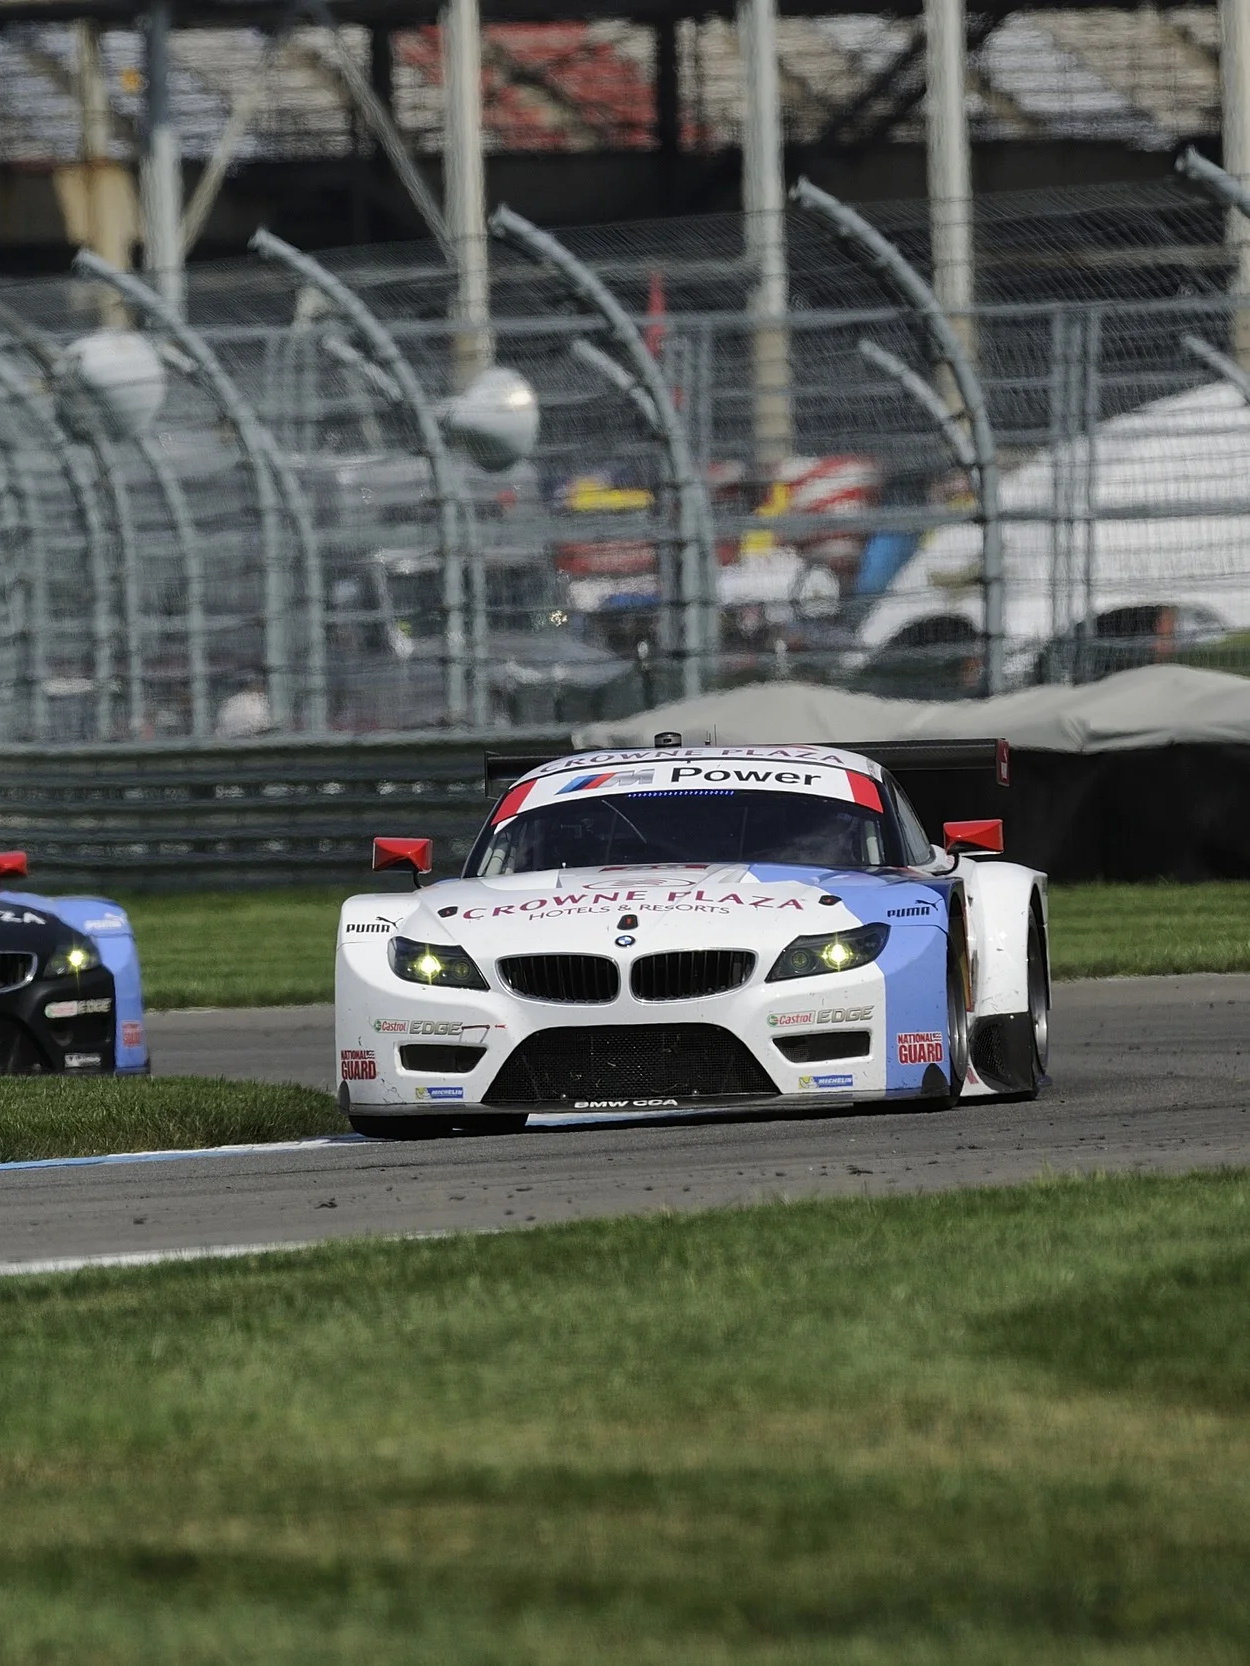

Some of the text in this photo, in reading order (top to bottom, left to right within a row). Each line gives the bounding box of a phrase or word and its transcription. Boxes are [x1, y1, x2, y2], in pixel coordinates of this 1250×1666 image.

[540, 749, 845, 773] CROWNE PLAZA
[670, 766, 822, 786] Power
[463, 890, 805, 921] CROWNE PLAZA
[529, 903, 730, 920] HOTELS & RESORTS
[887, 907, 930, 917] PUMA
[346, 924, 390, 933] PUMA
[779, 1005, 874, 1025] Castrol EDGE
[381, 1020, 463, 1035] Castrol EDGE
[898, 1033, 933, 1044] NATIONAL
[341, 1050, 367, 1059] NATIONAL
[899, 1043, 943, 1064] GUARD
[341, 1060, 377, 1080] GUARD
[431, 1088, 463, 1096] MICHELIN
